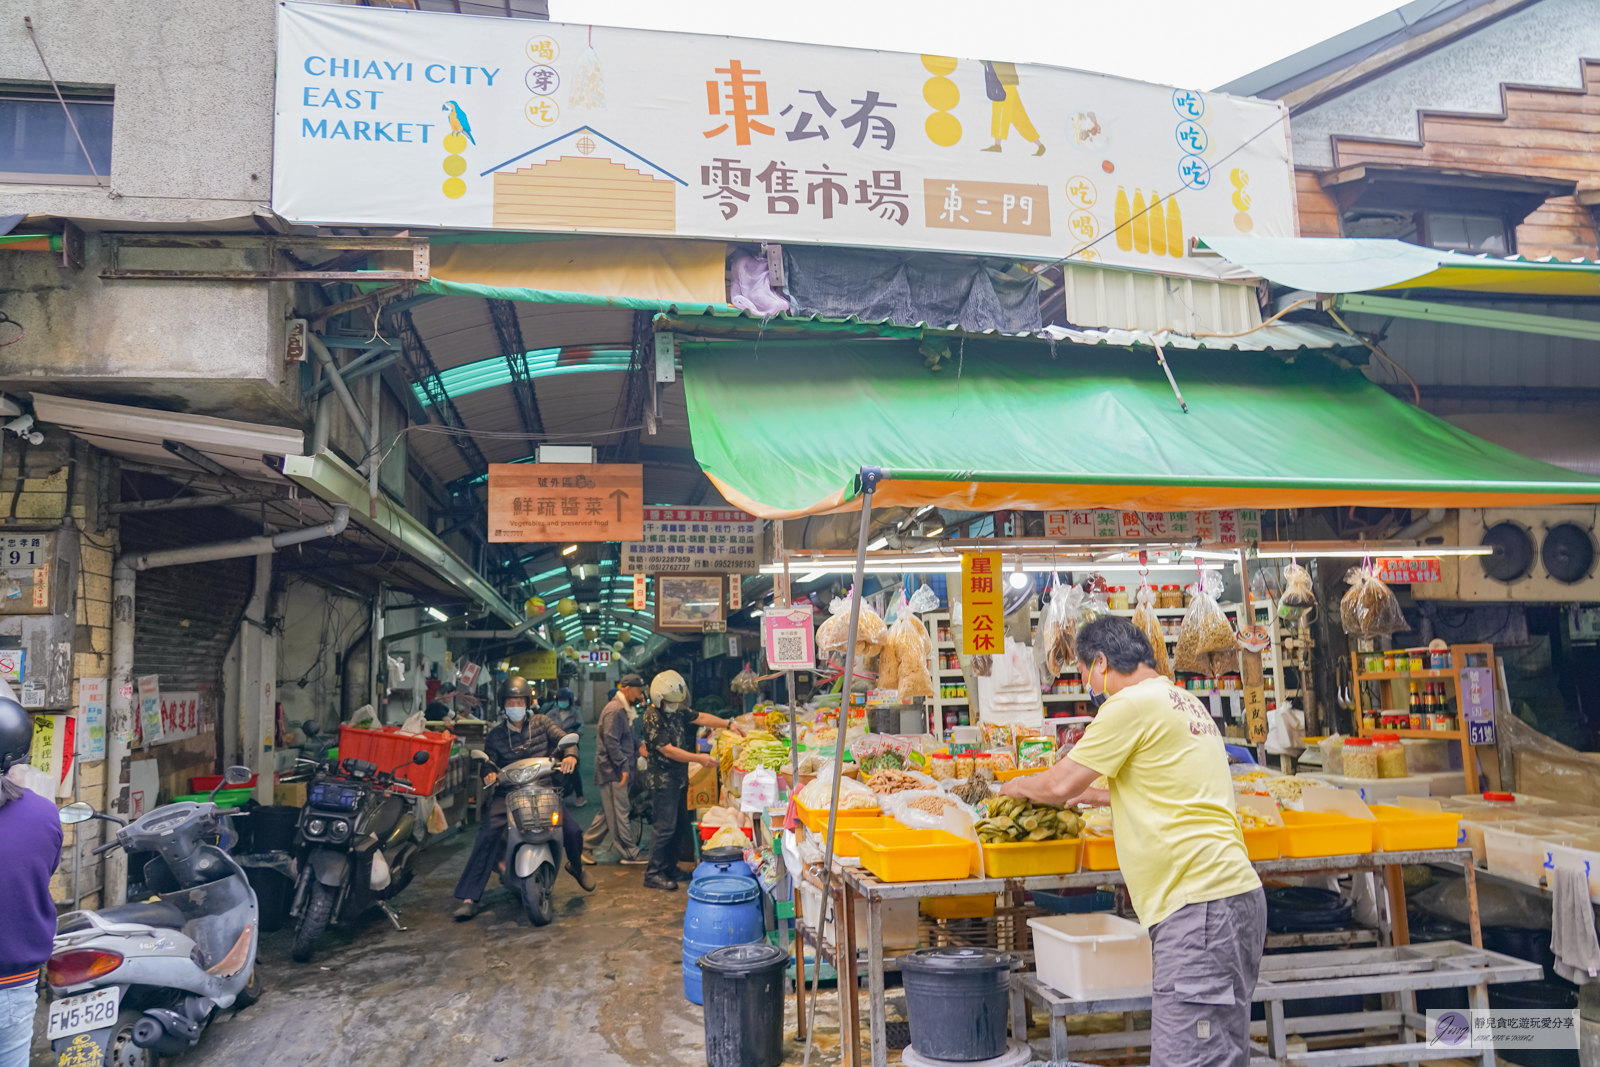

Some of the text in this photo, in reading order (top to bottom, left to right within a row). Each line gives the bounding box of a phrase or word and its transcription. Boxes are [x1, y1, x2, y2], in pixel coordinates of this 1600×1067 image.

[304, 56, 500, 86] CHIAYI CITY
[304, 87, 384, 111] EAST
[702, 59, 897, 150] 東公有
[302, 118, 435, 144] MARKET
[701, 158, 909, 227] 零售市場
[938, 183, 1034, 226] 東二門
[512, 497, 604, 516] 鮮蔬醬菜
[1072, 511, 1092, 525] 紅
[8, 538, 40, 547] 忠孝路
[9, 550, 37, 565] 91
[970, 557, 996, 651] 星期一公休
[1472, 725, 1493, 743] 51號
[67, 1041, 97, 1052] KYMCO
